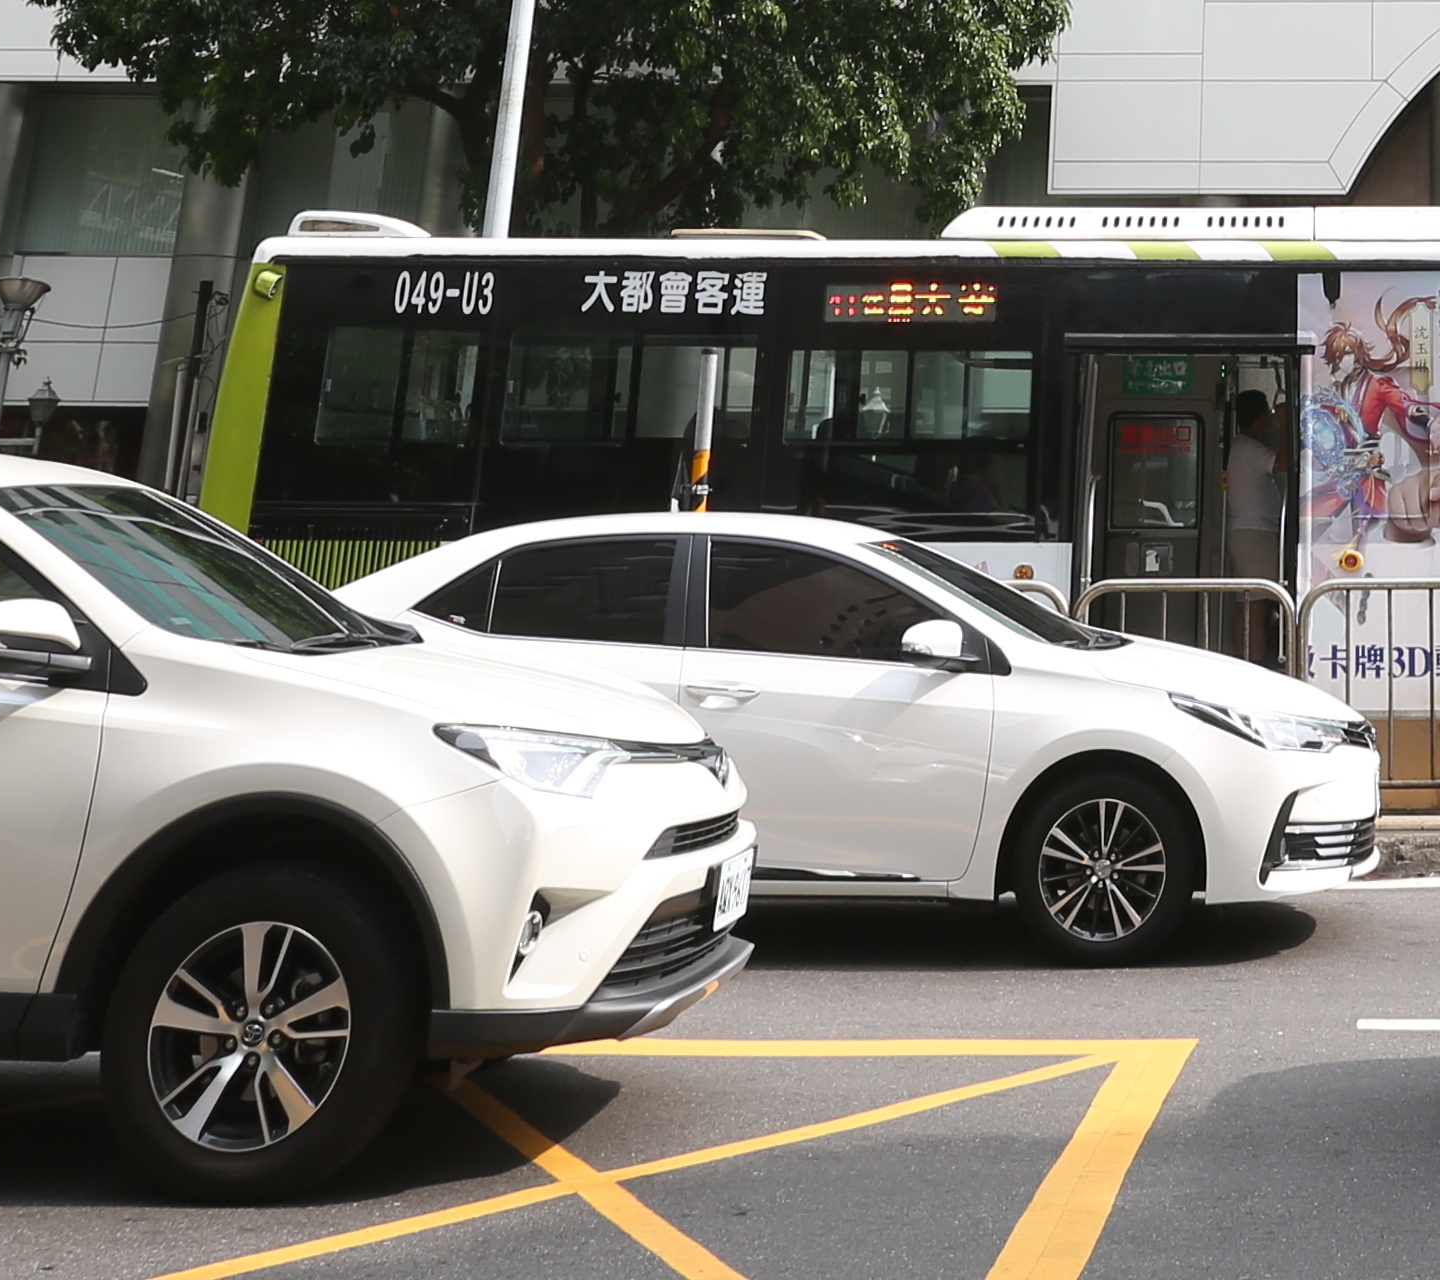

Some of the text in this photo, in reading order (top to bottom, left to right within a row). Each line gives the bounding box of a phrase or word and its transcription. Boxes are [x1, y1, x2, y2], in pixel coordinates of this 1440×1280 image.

[393, 269, 495, 317] 049-U3
[580, 269, 767, 317] 大都會客運
[1414, 325, 1429, 374] 沈玉琳
